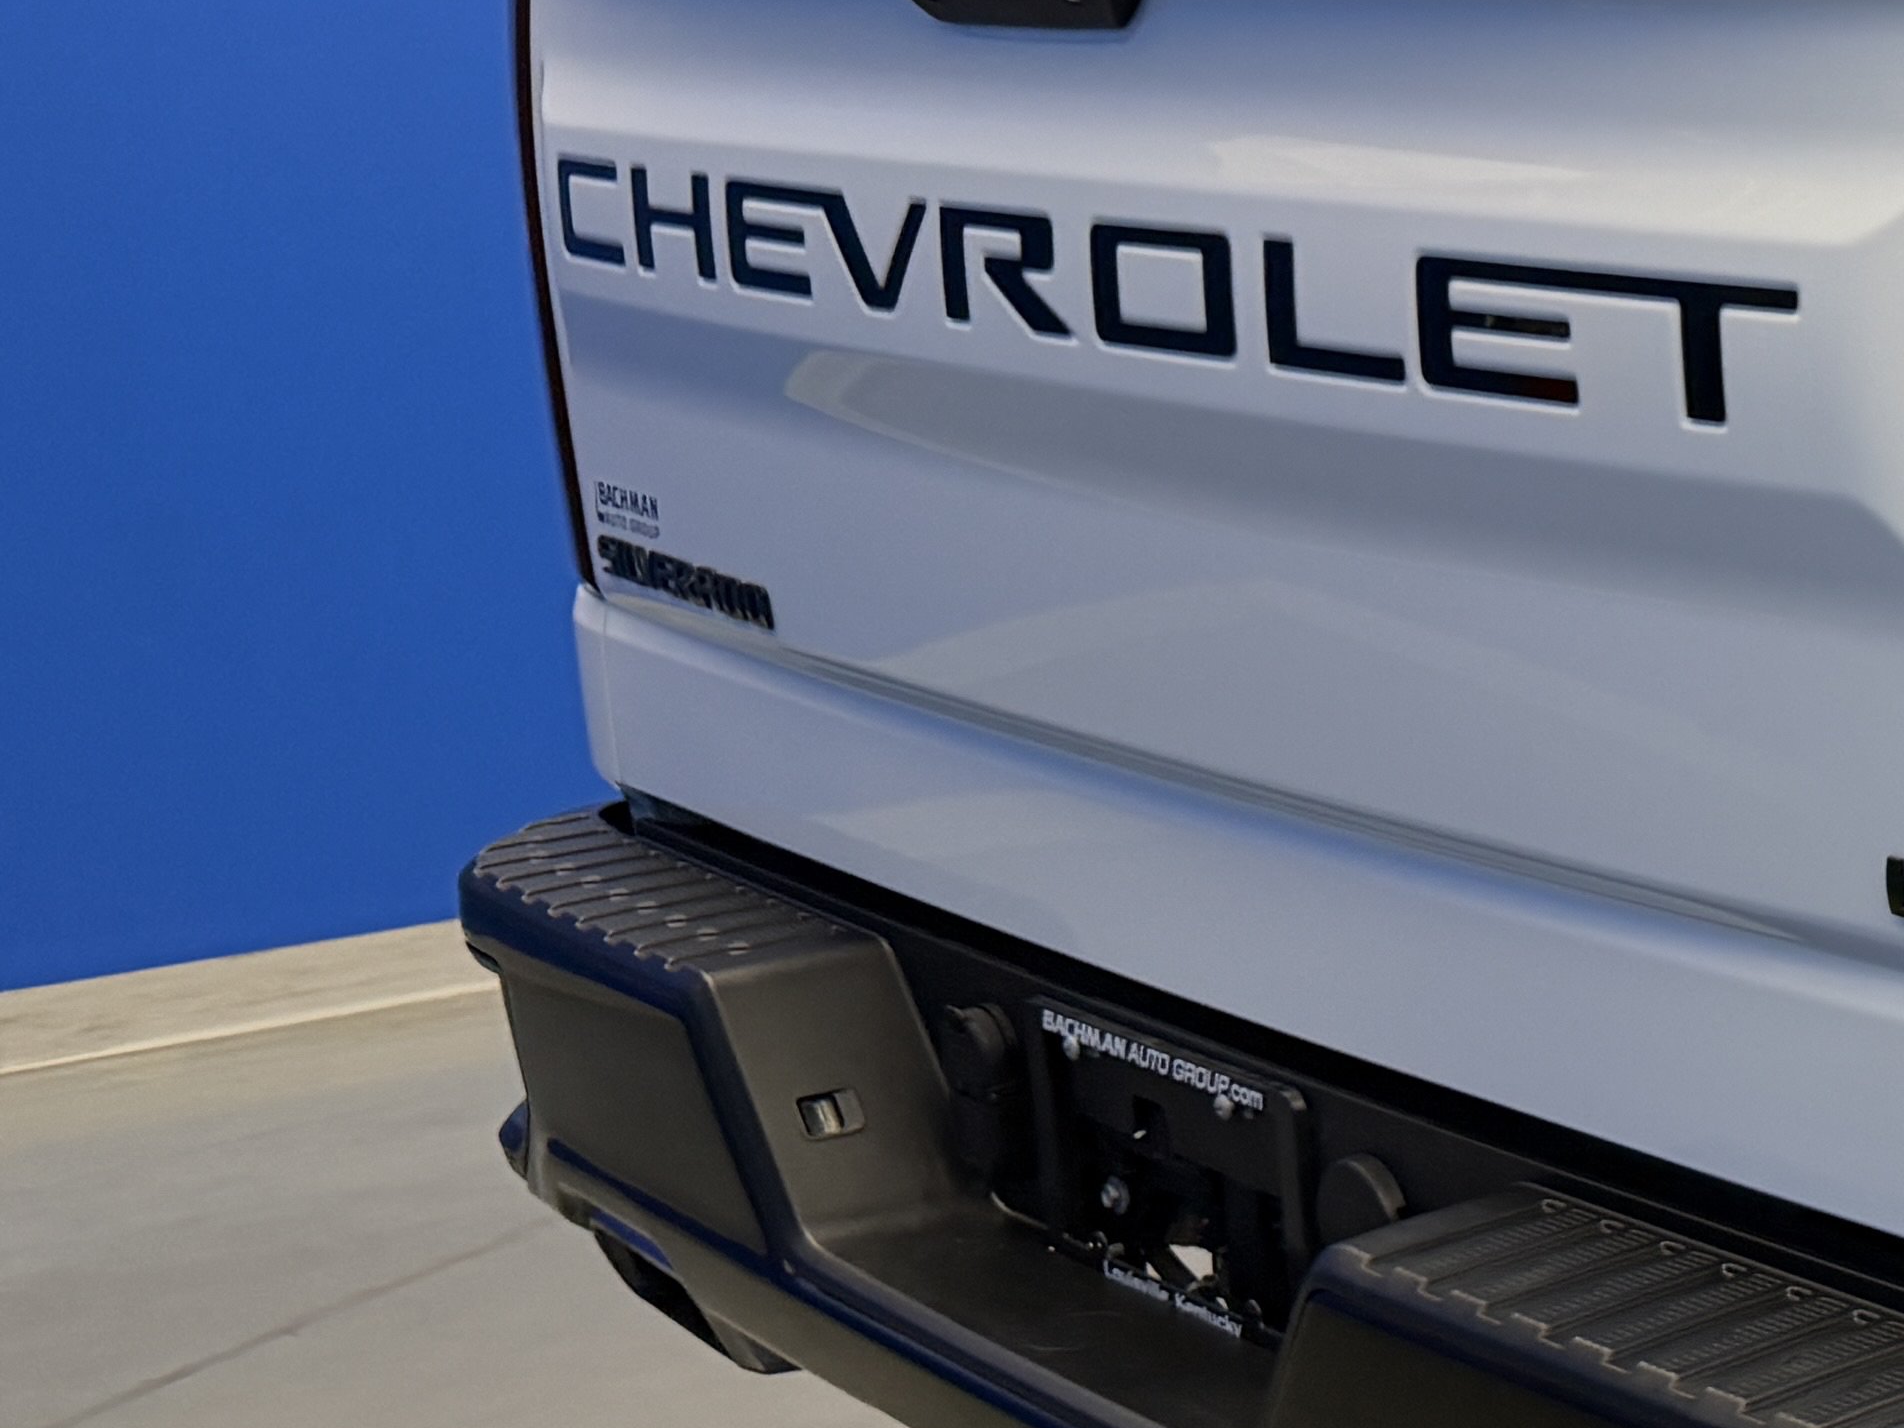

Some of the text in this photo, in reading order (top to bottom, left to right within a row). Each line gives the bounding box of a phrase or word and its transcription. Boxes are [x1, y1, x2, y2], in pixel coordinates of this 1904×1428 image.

[557, 158, 1799, 423] CHEVROLET
[597, 481, 659, 520] BACHMAN
[1042, 1009, 1126, 1059] BACHMAN
[1127, 1042, 1170, 1075] AUTO
